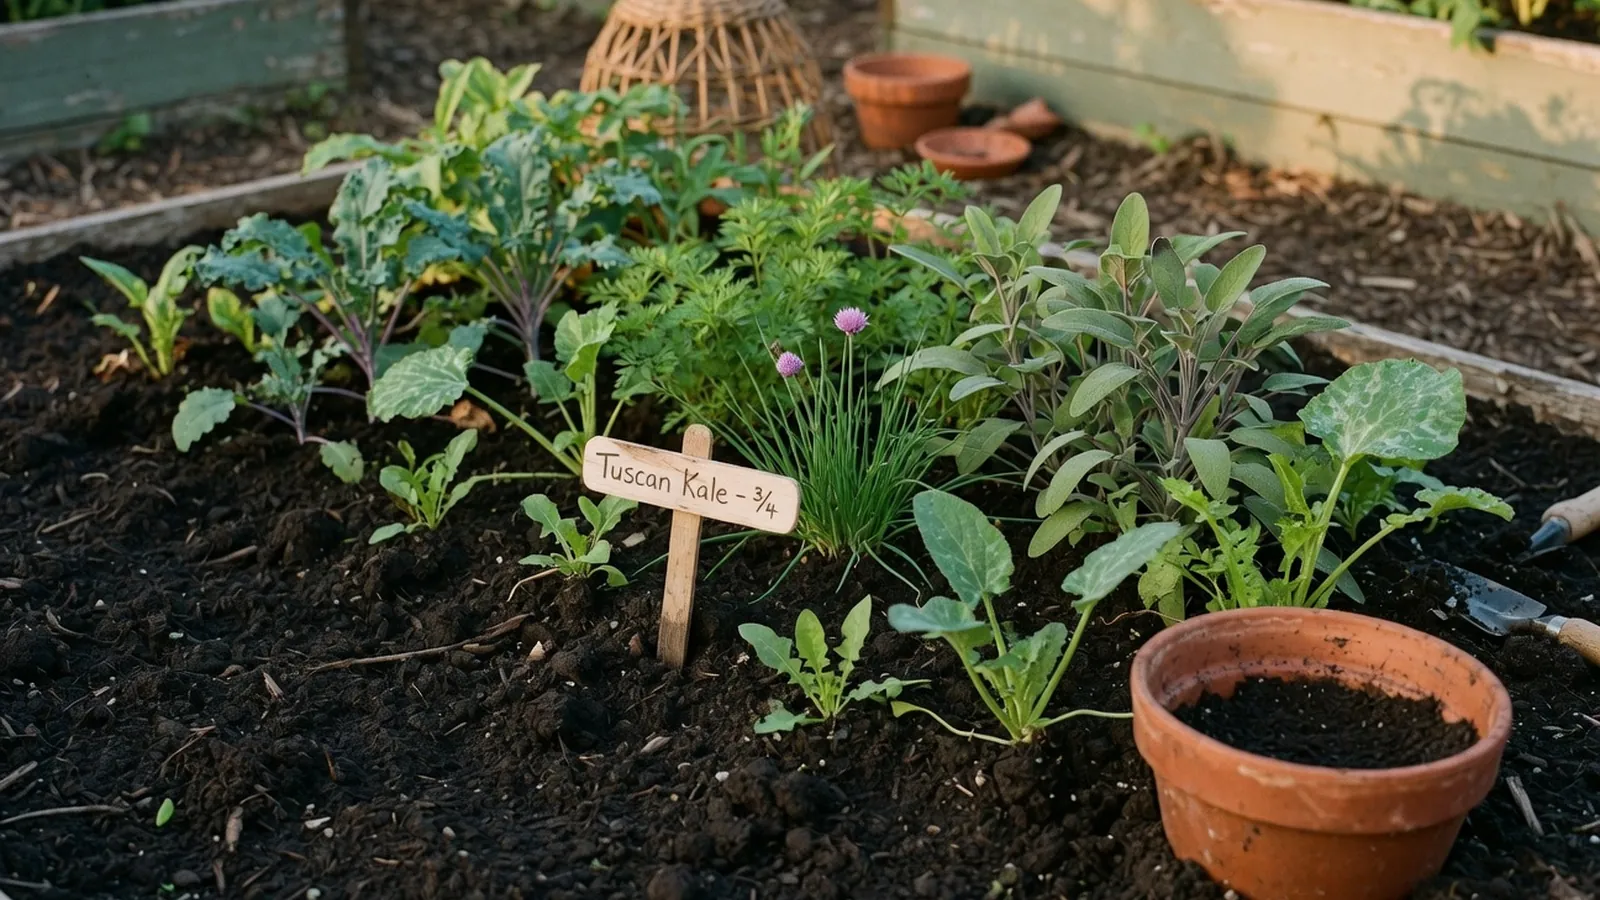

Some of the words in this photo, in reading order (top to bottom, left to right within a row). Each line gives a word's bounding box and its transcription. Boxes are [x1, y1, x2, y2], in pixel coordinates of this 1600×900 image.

[596, 452, 670, 493] Tuscan
[682, 468, 729, 504] Kale
[753, 486, 779, 519] 3/4
